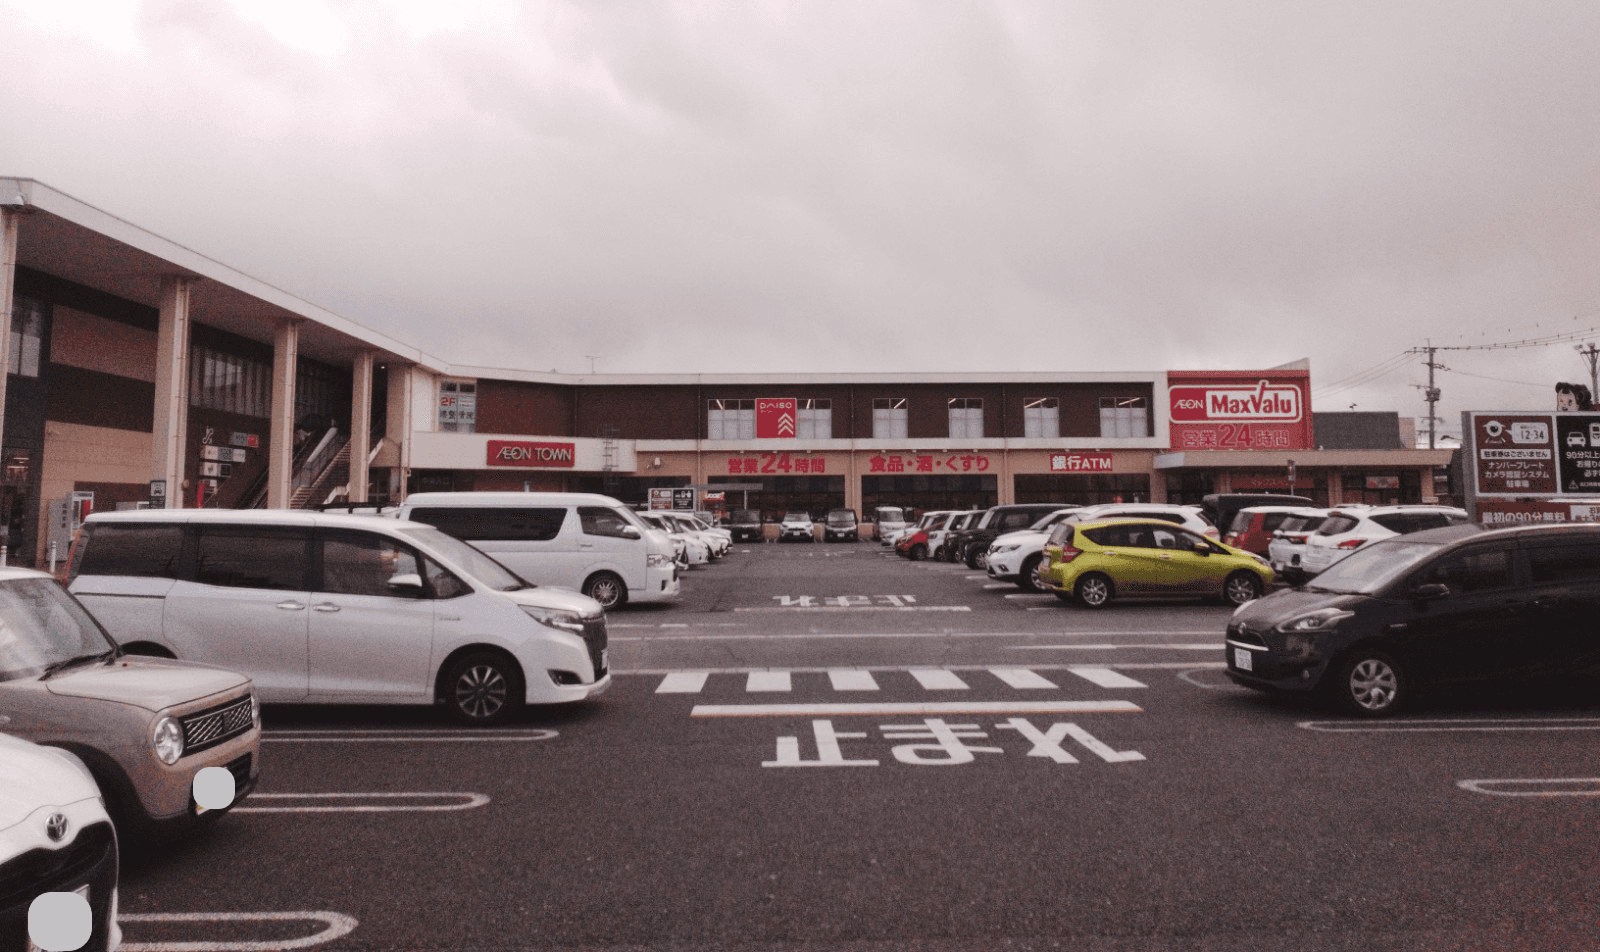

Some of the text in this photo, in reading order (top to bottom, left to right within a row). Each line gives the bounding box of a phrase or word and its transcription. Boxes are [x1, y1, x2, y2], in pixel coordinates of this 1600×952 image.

[441, 397, 455, 406] 2F
[1211, 381, 1292, 414] MaxValu
[1182, 423, 1291, 448] 営業24時間
[535, 447, 572, 461] TOWN
[727, 453, 826, 475] 営業24時間
[869, 453, 990, 474] 食品・酒・くすり
[1052, 455, 1112, 470] 銀行ATM
[1488, 461, 1545, 469] ナンバープレート
[761, 718, 1147, 768] 止まれ
